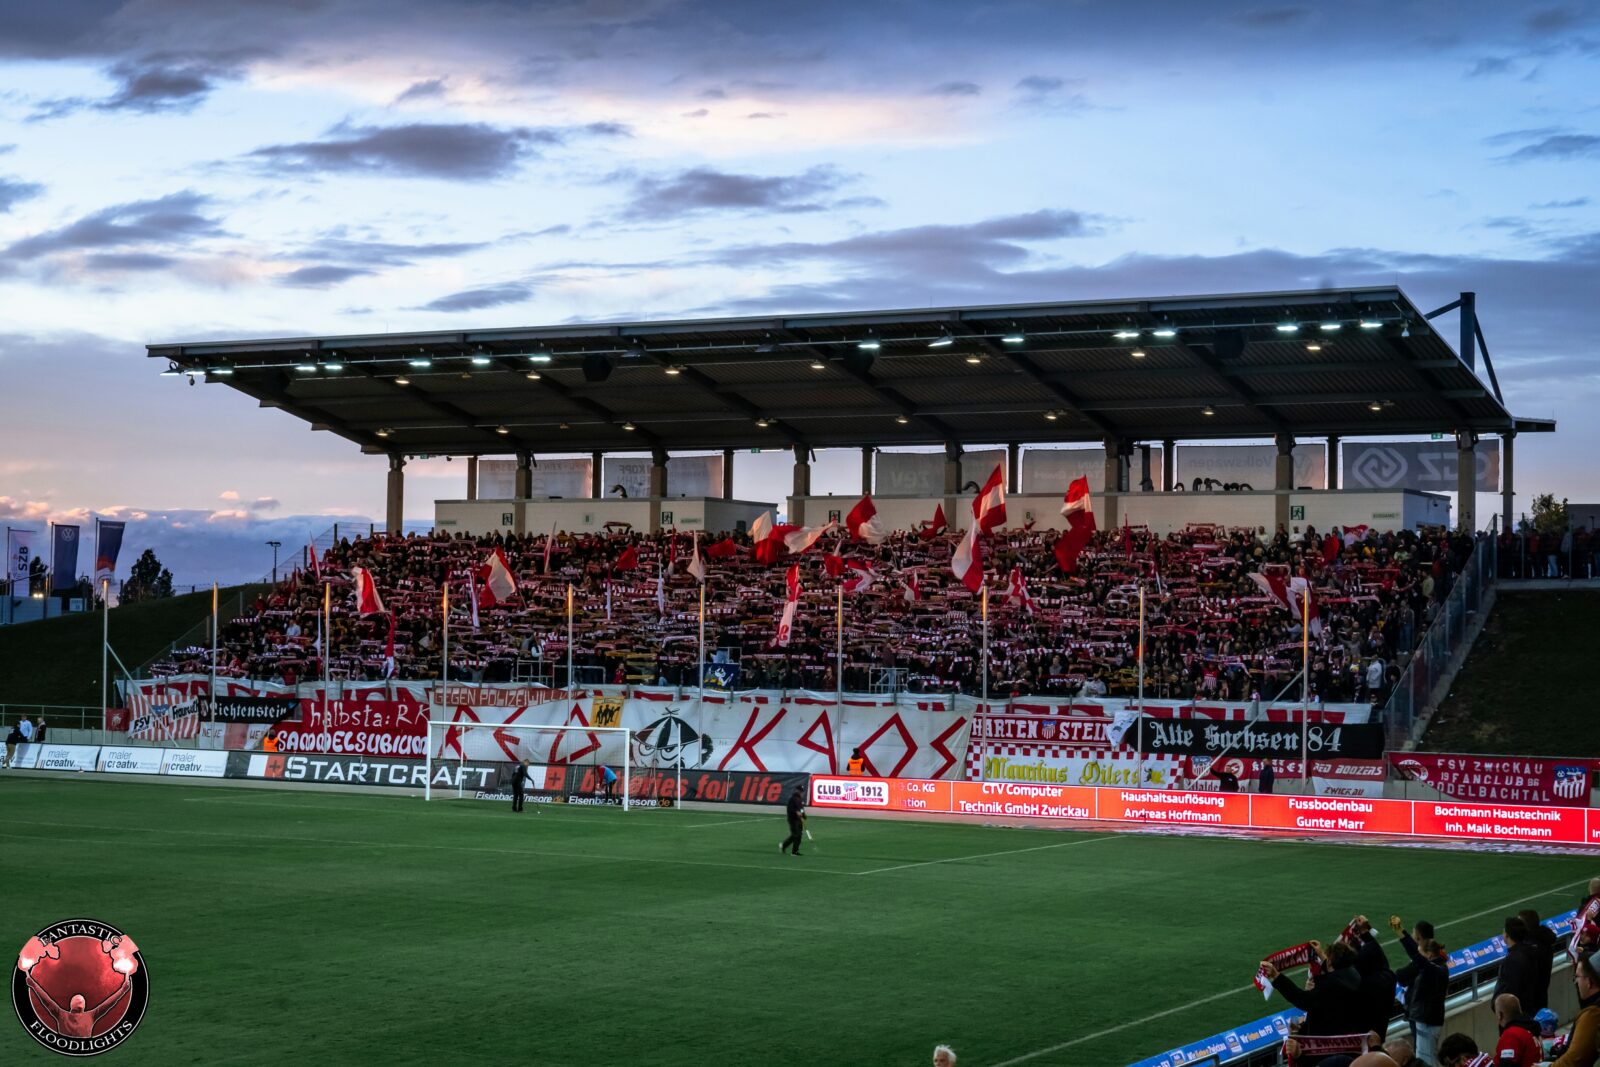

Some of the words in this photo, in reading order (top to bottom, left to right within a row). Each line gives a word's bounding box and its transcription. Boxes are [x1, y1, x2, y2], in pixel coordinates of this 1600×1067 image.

[18, 546, 28, 571] SZB
[971, 717, 1039, 739] HARTEN
[1149, 721, 1194, 748] Alte
[1203, 725, 1300, 753] Sachsen
[1307, 726, 1342, 752] 84
[172, 752, 196, 762] maler
[284, 756, 495, 787] STARTCRAFT
[1437, 759, 1466, 771] FSV
[1474, 761, 1543, 774] ZWICKAU
[693, 774, 734, 799] for
[738, 775, 782, 801] life
[1452, 773, 1524, 787] FANCLUB
[817, 784, 842, 795] CLUB
[860, 786, 883, 797] 1912
[922, 783, 936, 793] KG
[982, 783, 1005, 795] CTV
[1006, 784, 1064, 798] Computer
[1121, 792, 1226, 808] Haushaltsauflösung
[1288, 799, 1373, 813] Fussbodenbau
[959, 801, 1003, 814] Technik
[1005, 803, 1039, 816] GmbH
[1041, 804, 1089, 817] Zwickau
[1125, 808, 1167, 820] Andreas
[1169, 809, 1223, 823] Hoffmann
[1434, 806, 1491, 818] Bochmann
[1493, 808, 1561, 821] Haustechnik
[1296, 816, 1336, 829] Gunter
[1338, 818, 1365, 830] Marr
[1445, 822, 1466, 833] Inh.
[1468, 823, 1492, 834] Maik
[1494, 825, 1552, 837] Bochmann
